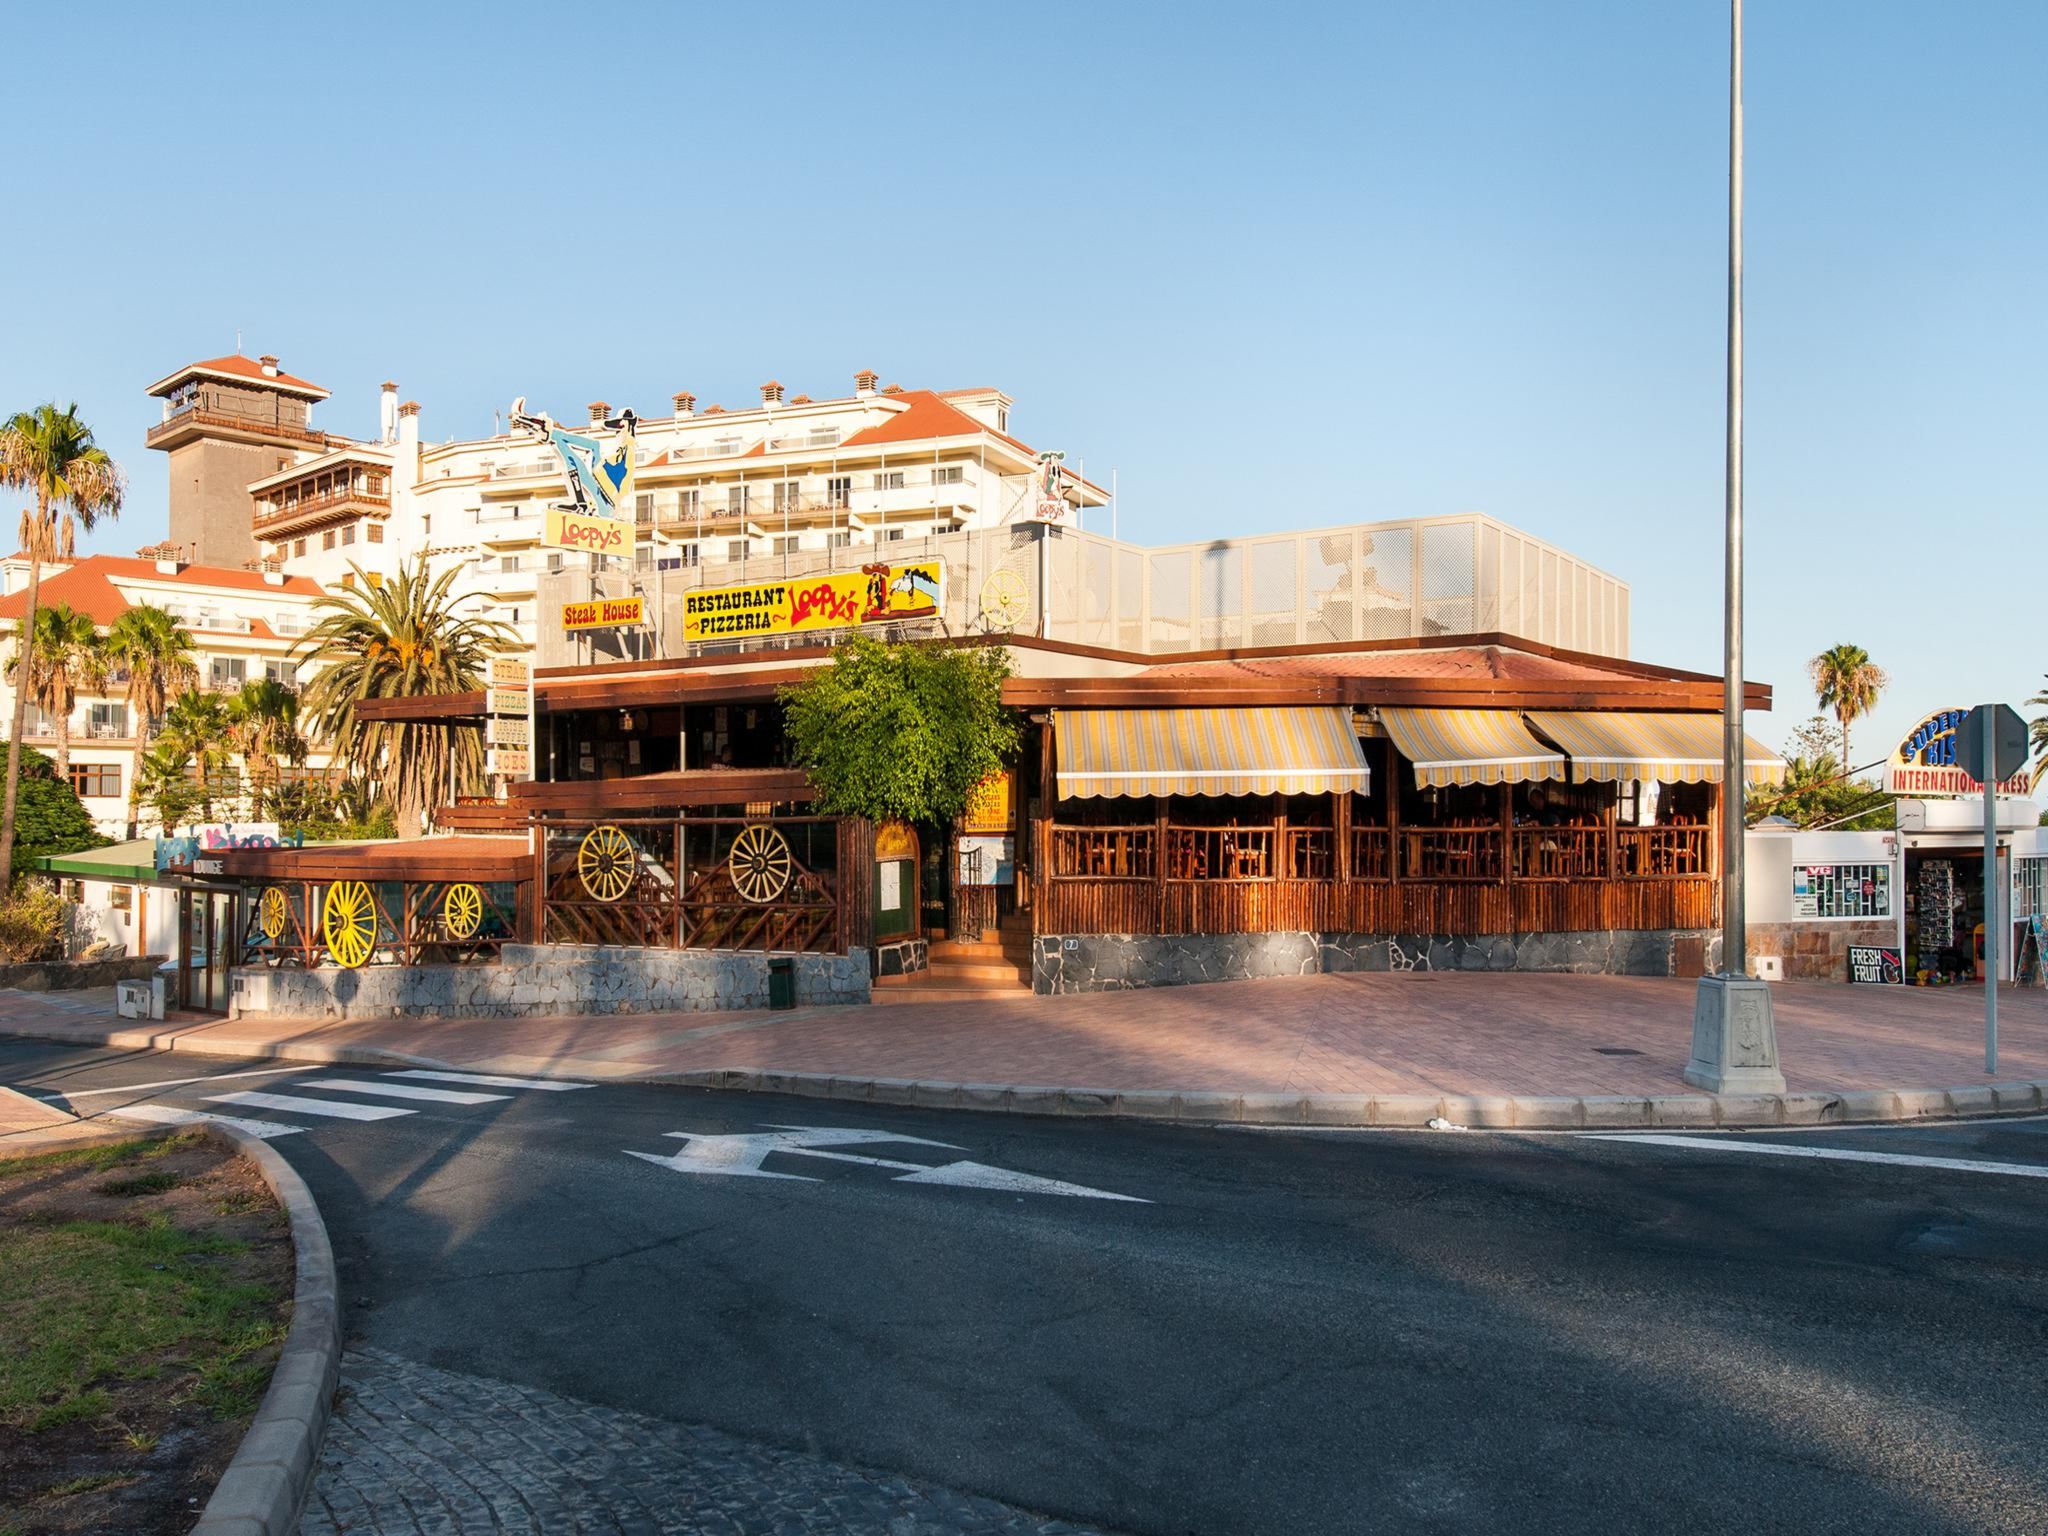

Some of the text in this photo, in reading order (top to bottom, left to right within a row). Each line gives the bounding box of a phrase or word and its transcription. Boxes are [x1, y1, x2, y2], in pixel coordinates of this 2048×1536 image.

[560, 516, 622, 550] Loopy's
[687, 588, 785, 614] RESTAURANT
[788, 583, 860, 628] Loopy's
[565, 603, 639, 625] Steak House
[700, 612, 771, 634] PIZZERIA
[494, 694, 528, 710] PIZZAS
[1893, 769, 1984, 793] INTERNATIONA
[1808, 866, 1832, 875] VG
[1851, 948, 1882, 965] FRESH
[1854, 965, 1881, 982] FRUIT
